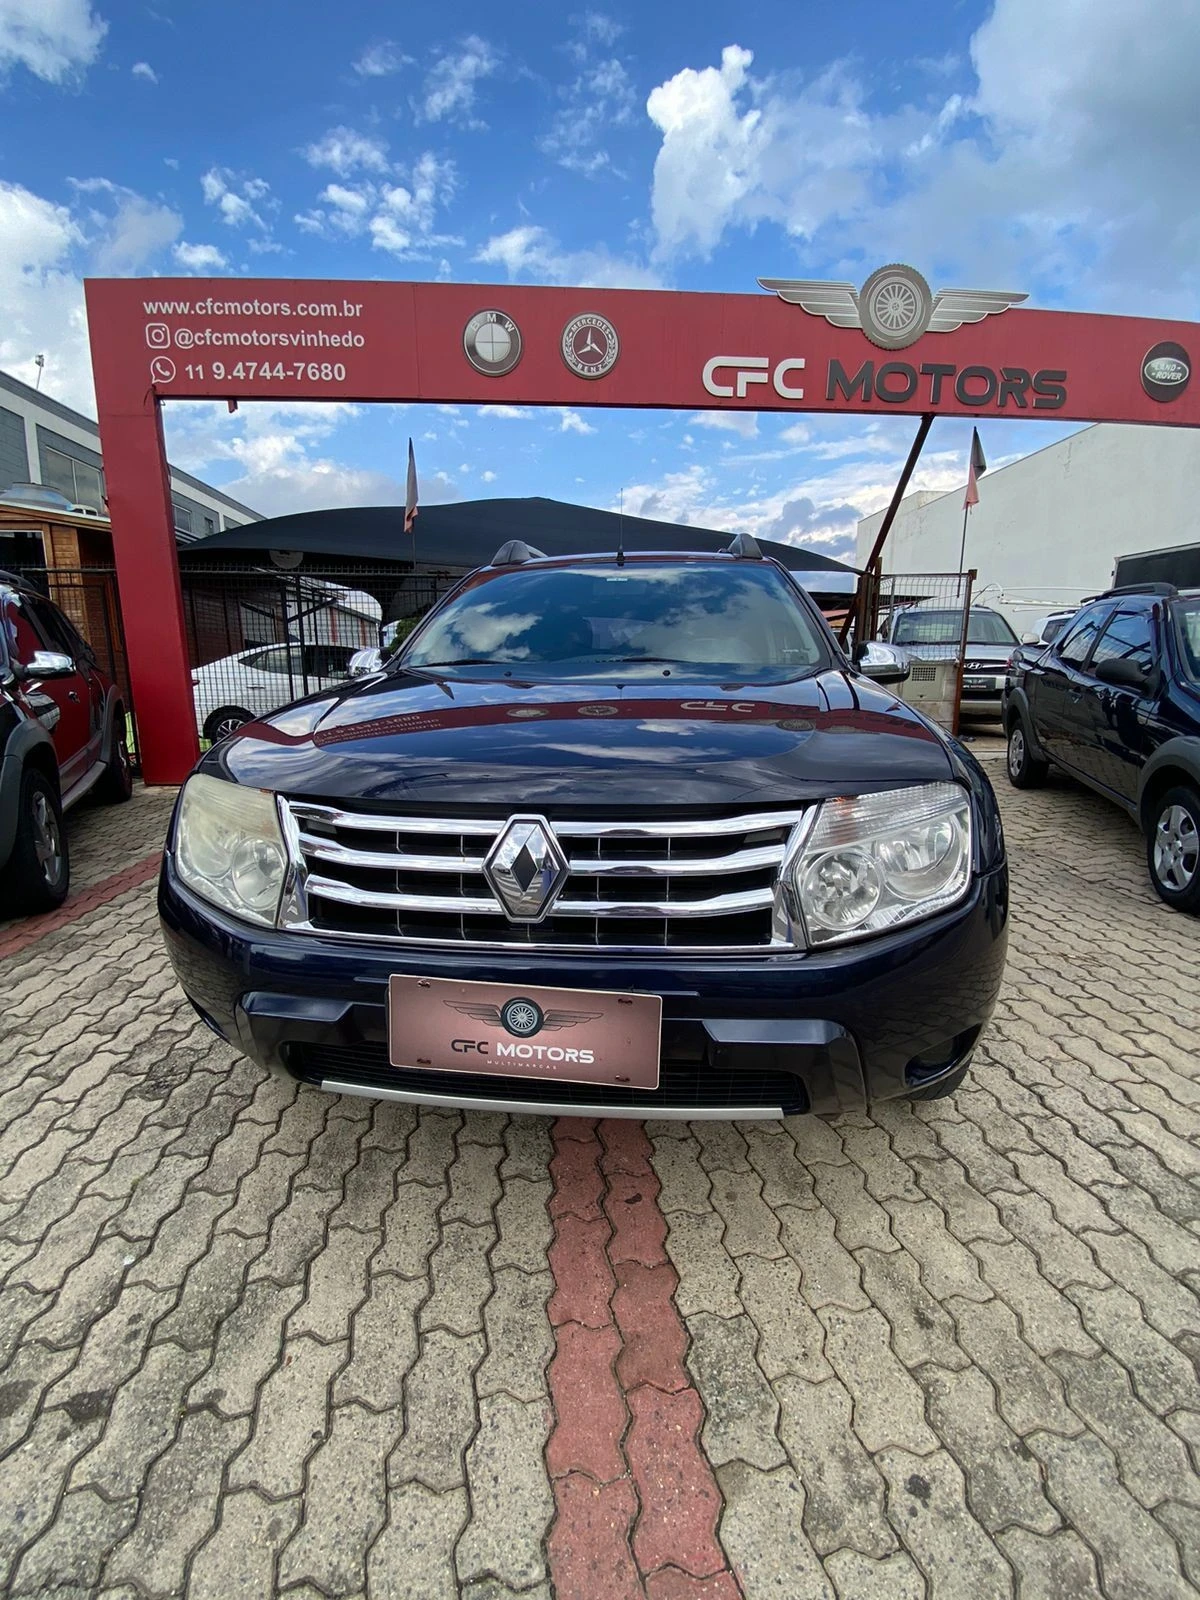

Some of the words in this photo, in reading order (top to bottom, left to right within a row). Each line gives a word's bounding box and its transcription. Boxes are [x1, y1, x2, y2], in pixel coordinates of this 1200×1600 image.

[143, 298, 363, 317] www.cfcmotors.com.br
[471, 313, 515, 333] BMW
[571, 317, 611, 335] MERCEDES
[174, 328, 365, 349] @cfcmotorsvinhedo
[185, 364, 204, 380] 11
[212, 362, 346, 381] 9.4744-7680
[1155, 371, 1182, 380] ROVER
[702, 356, 806, 400] CFC
[826, 359, 1068, 409] MOTORS
[451, 1038, 489, 1055] CFC
[496, 1042, 595, 1064] MOTORS
[487, 1060, 557, 1070] MULTIMARCAS
